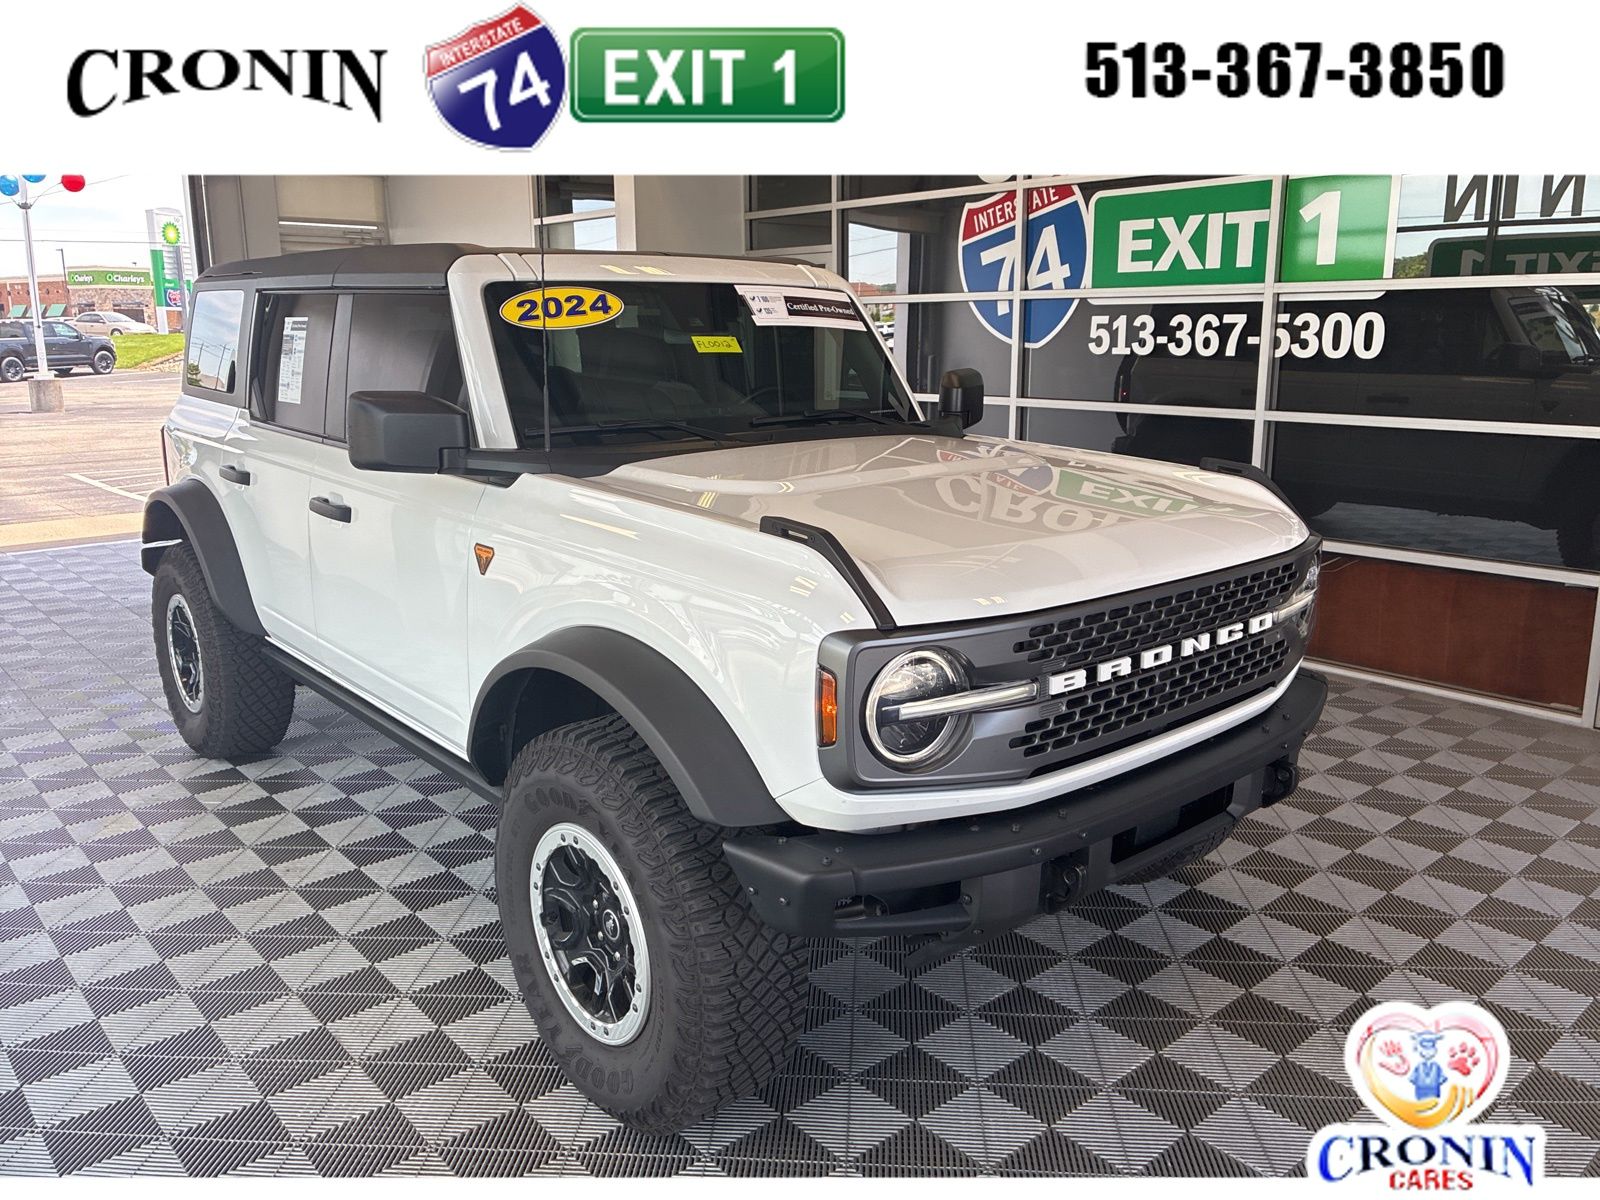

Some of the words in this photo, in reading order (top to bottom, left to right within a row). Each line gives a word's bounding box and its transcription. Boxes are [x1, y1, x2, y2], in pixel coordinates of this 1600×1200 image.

[1117, 209, 1270, 273] EXIT
[1299, 191, 1341, 265] 1
[980, 223, 1071, 316] 74
[516, 293, 613, 322] 2024
[787, 302, 818, 312] Certified
[819, 304, 855, 315] Pre-Owned
[1087, 311, 1386, 360] 513-367-5300
[1049, 612, 1273, 695] BRONCO
